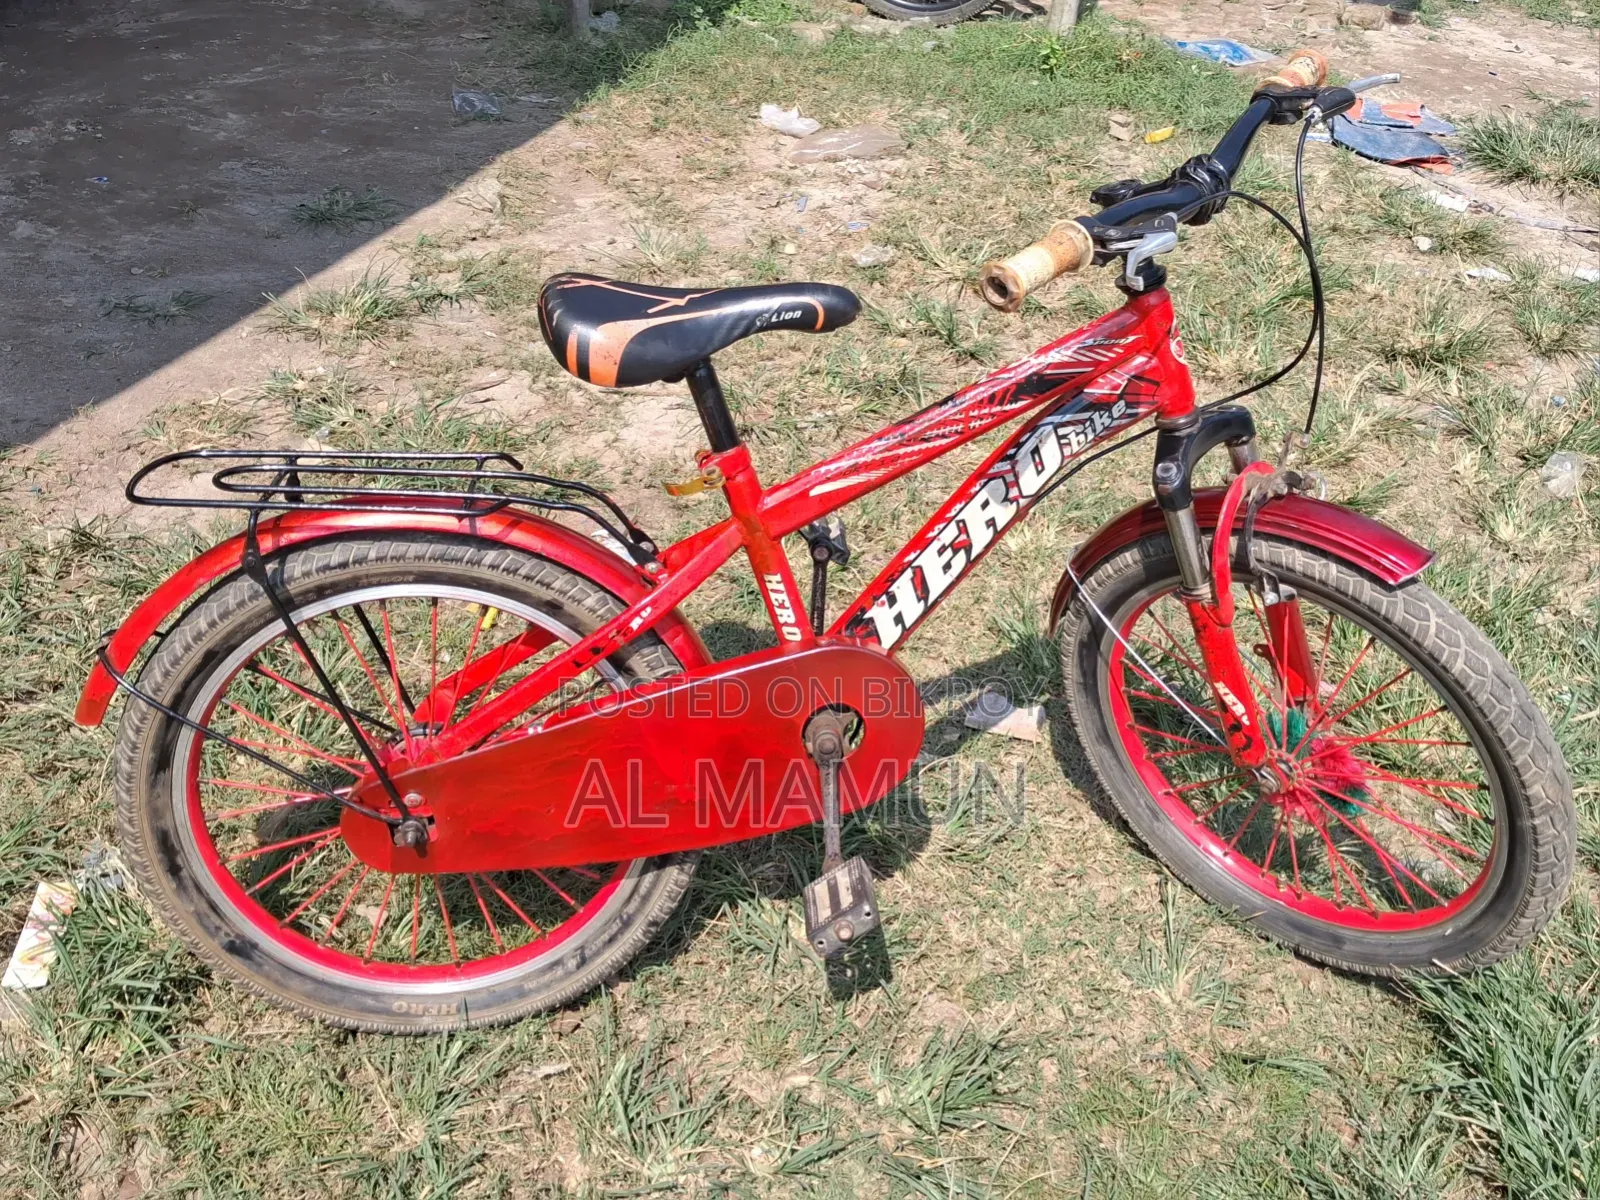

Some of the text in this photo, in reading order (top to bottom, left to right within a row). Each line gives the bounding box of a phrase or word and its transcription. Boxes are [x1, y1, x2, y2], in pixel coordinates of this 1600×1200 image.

[864, 400, 1126, 650] HERO bike
[763, 573, 802, 642] HERO
